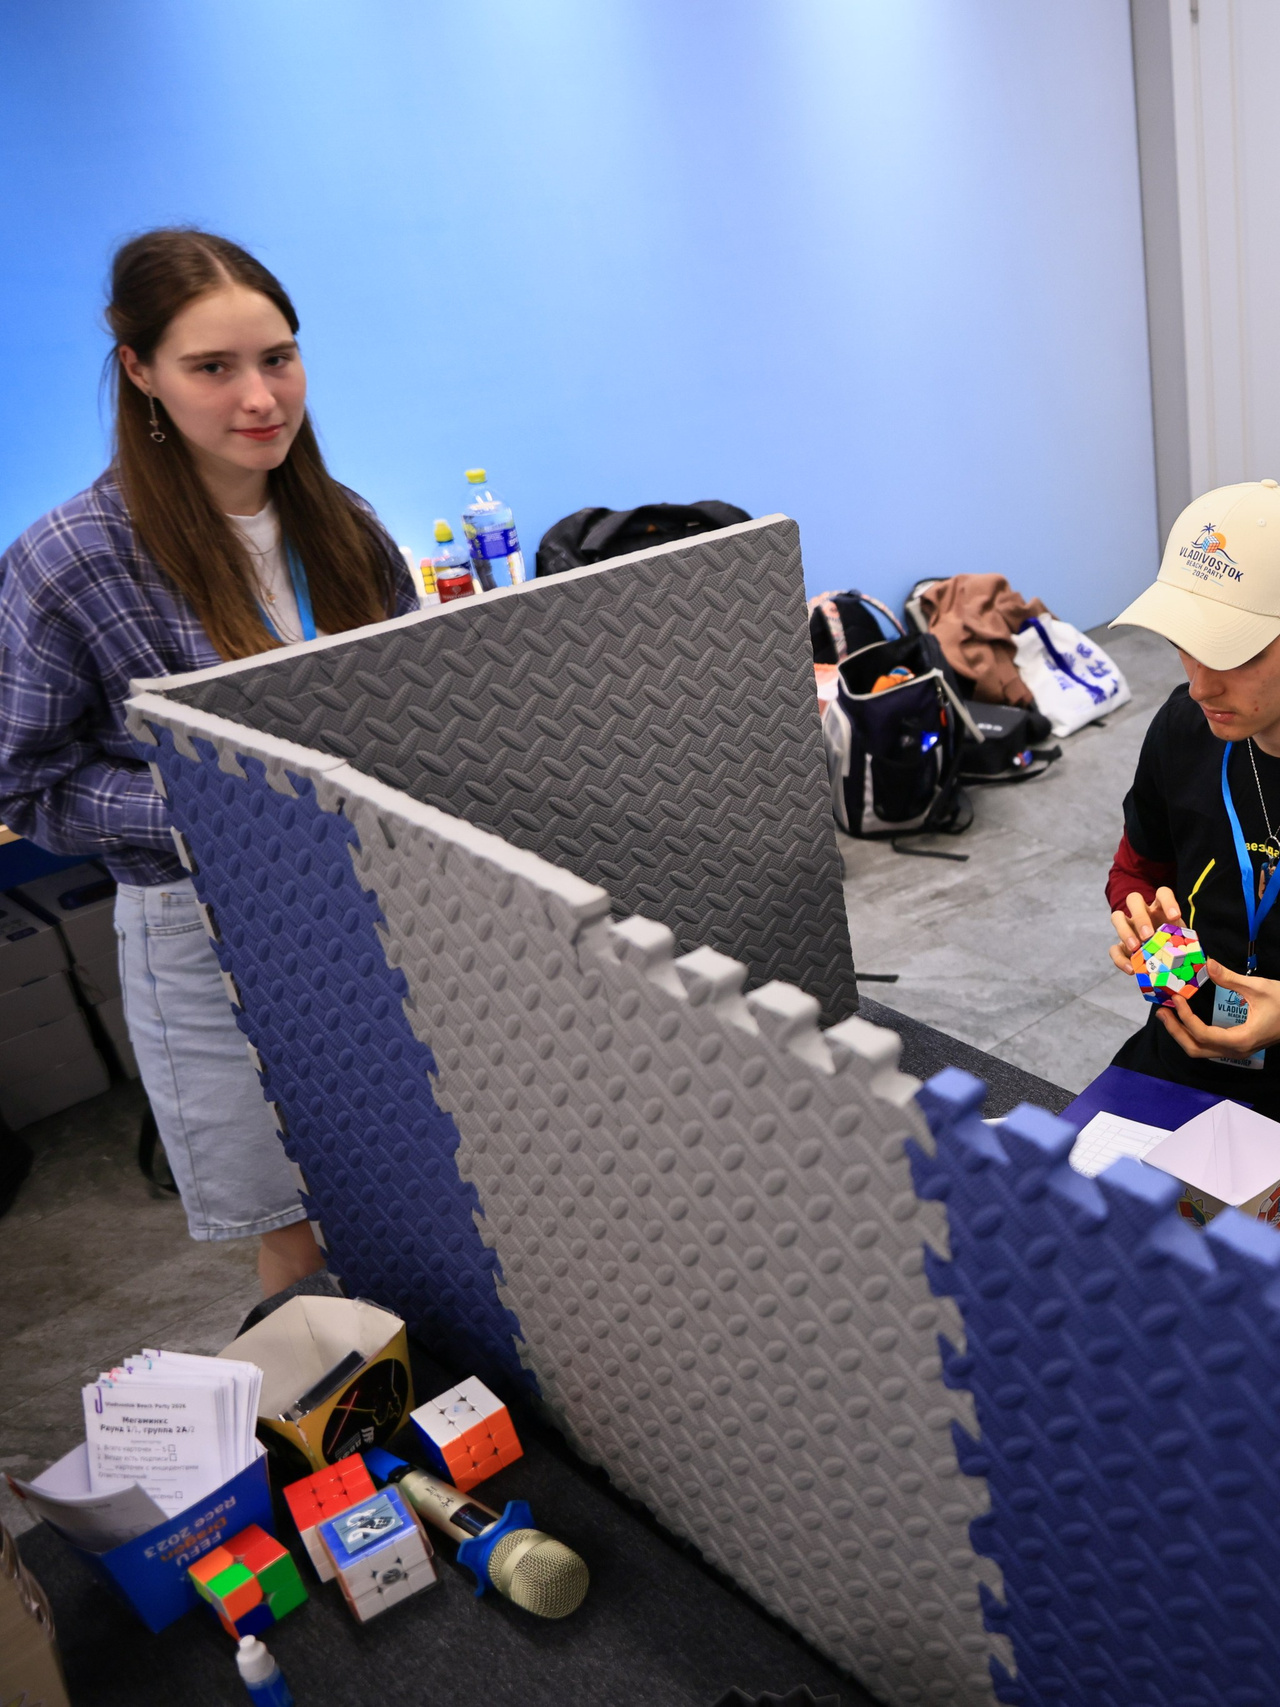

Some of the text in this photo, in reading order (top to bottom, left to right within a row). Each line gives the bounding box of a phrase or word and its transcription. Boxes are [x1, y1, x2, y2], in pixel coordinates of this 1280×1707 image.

[1179, 546, 1244, 582] VLADIVOSTOK
[1186, 559, 1224, 580] BEACH PARTY
[1192, 569, 1209, 581] 2026
[1245, 842, 1280, 858] везда
[1217, 1003, 1248, 1015] VLADIVO
[122, 1416, 168, 1424] Мегаминкс
[100, 1423, 124, 1434] Раунд
[143, 1426, 173, 1435] группа
[144, 1495, 236, 1559] Race 2023
[176, 1530, 222, 1567] FEFU
